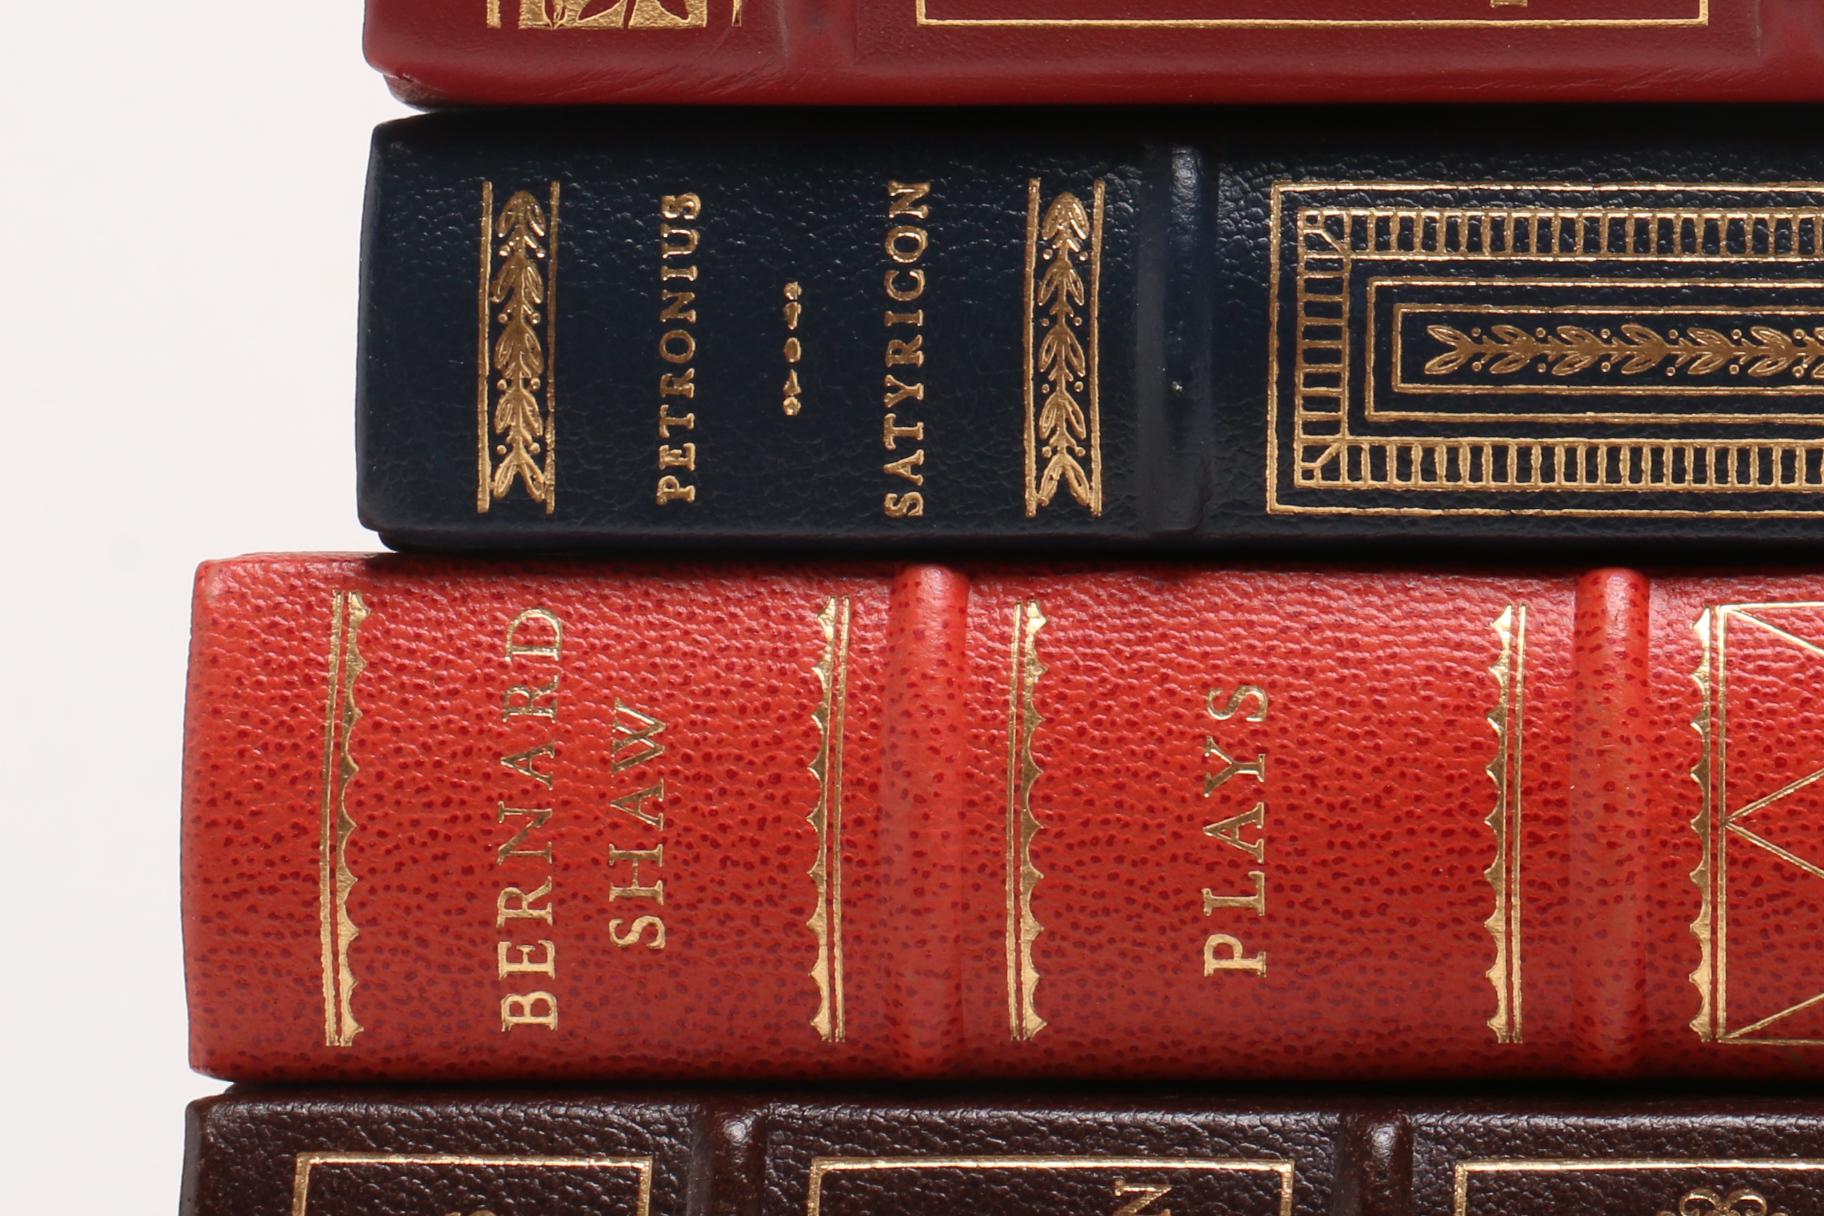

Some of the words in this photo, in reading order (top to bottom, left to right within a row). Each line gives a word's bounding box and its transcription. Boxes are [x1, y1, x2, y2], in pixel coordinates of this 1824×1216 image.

[656, 192, 702, 506] PETRONIUS
[883, 179, 931, 518] SATYRICON
[496, 607, 563, 1032] BERNARD
[608, 698, 667, 950] SHAW
[1202, 685, 1268, 978] PLAYS
